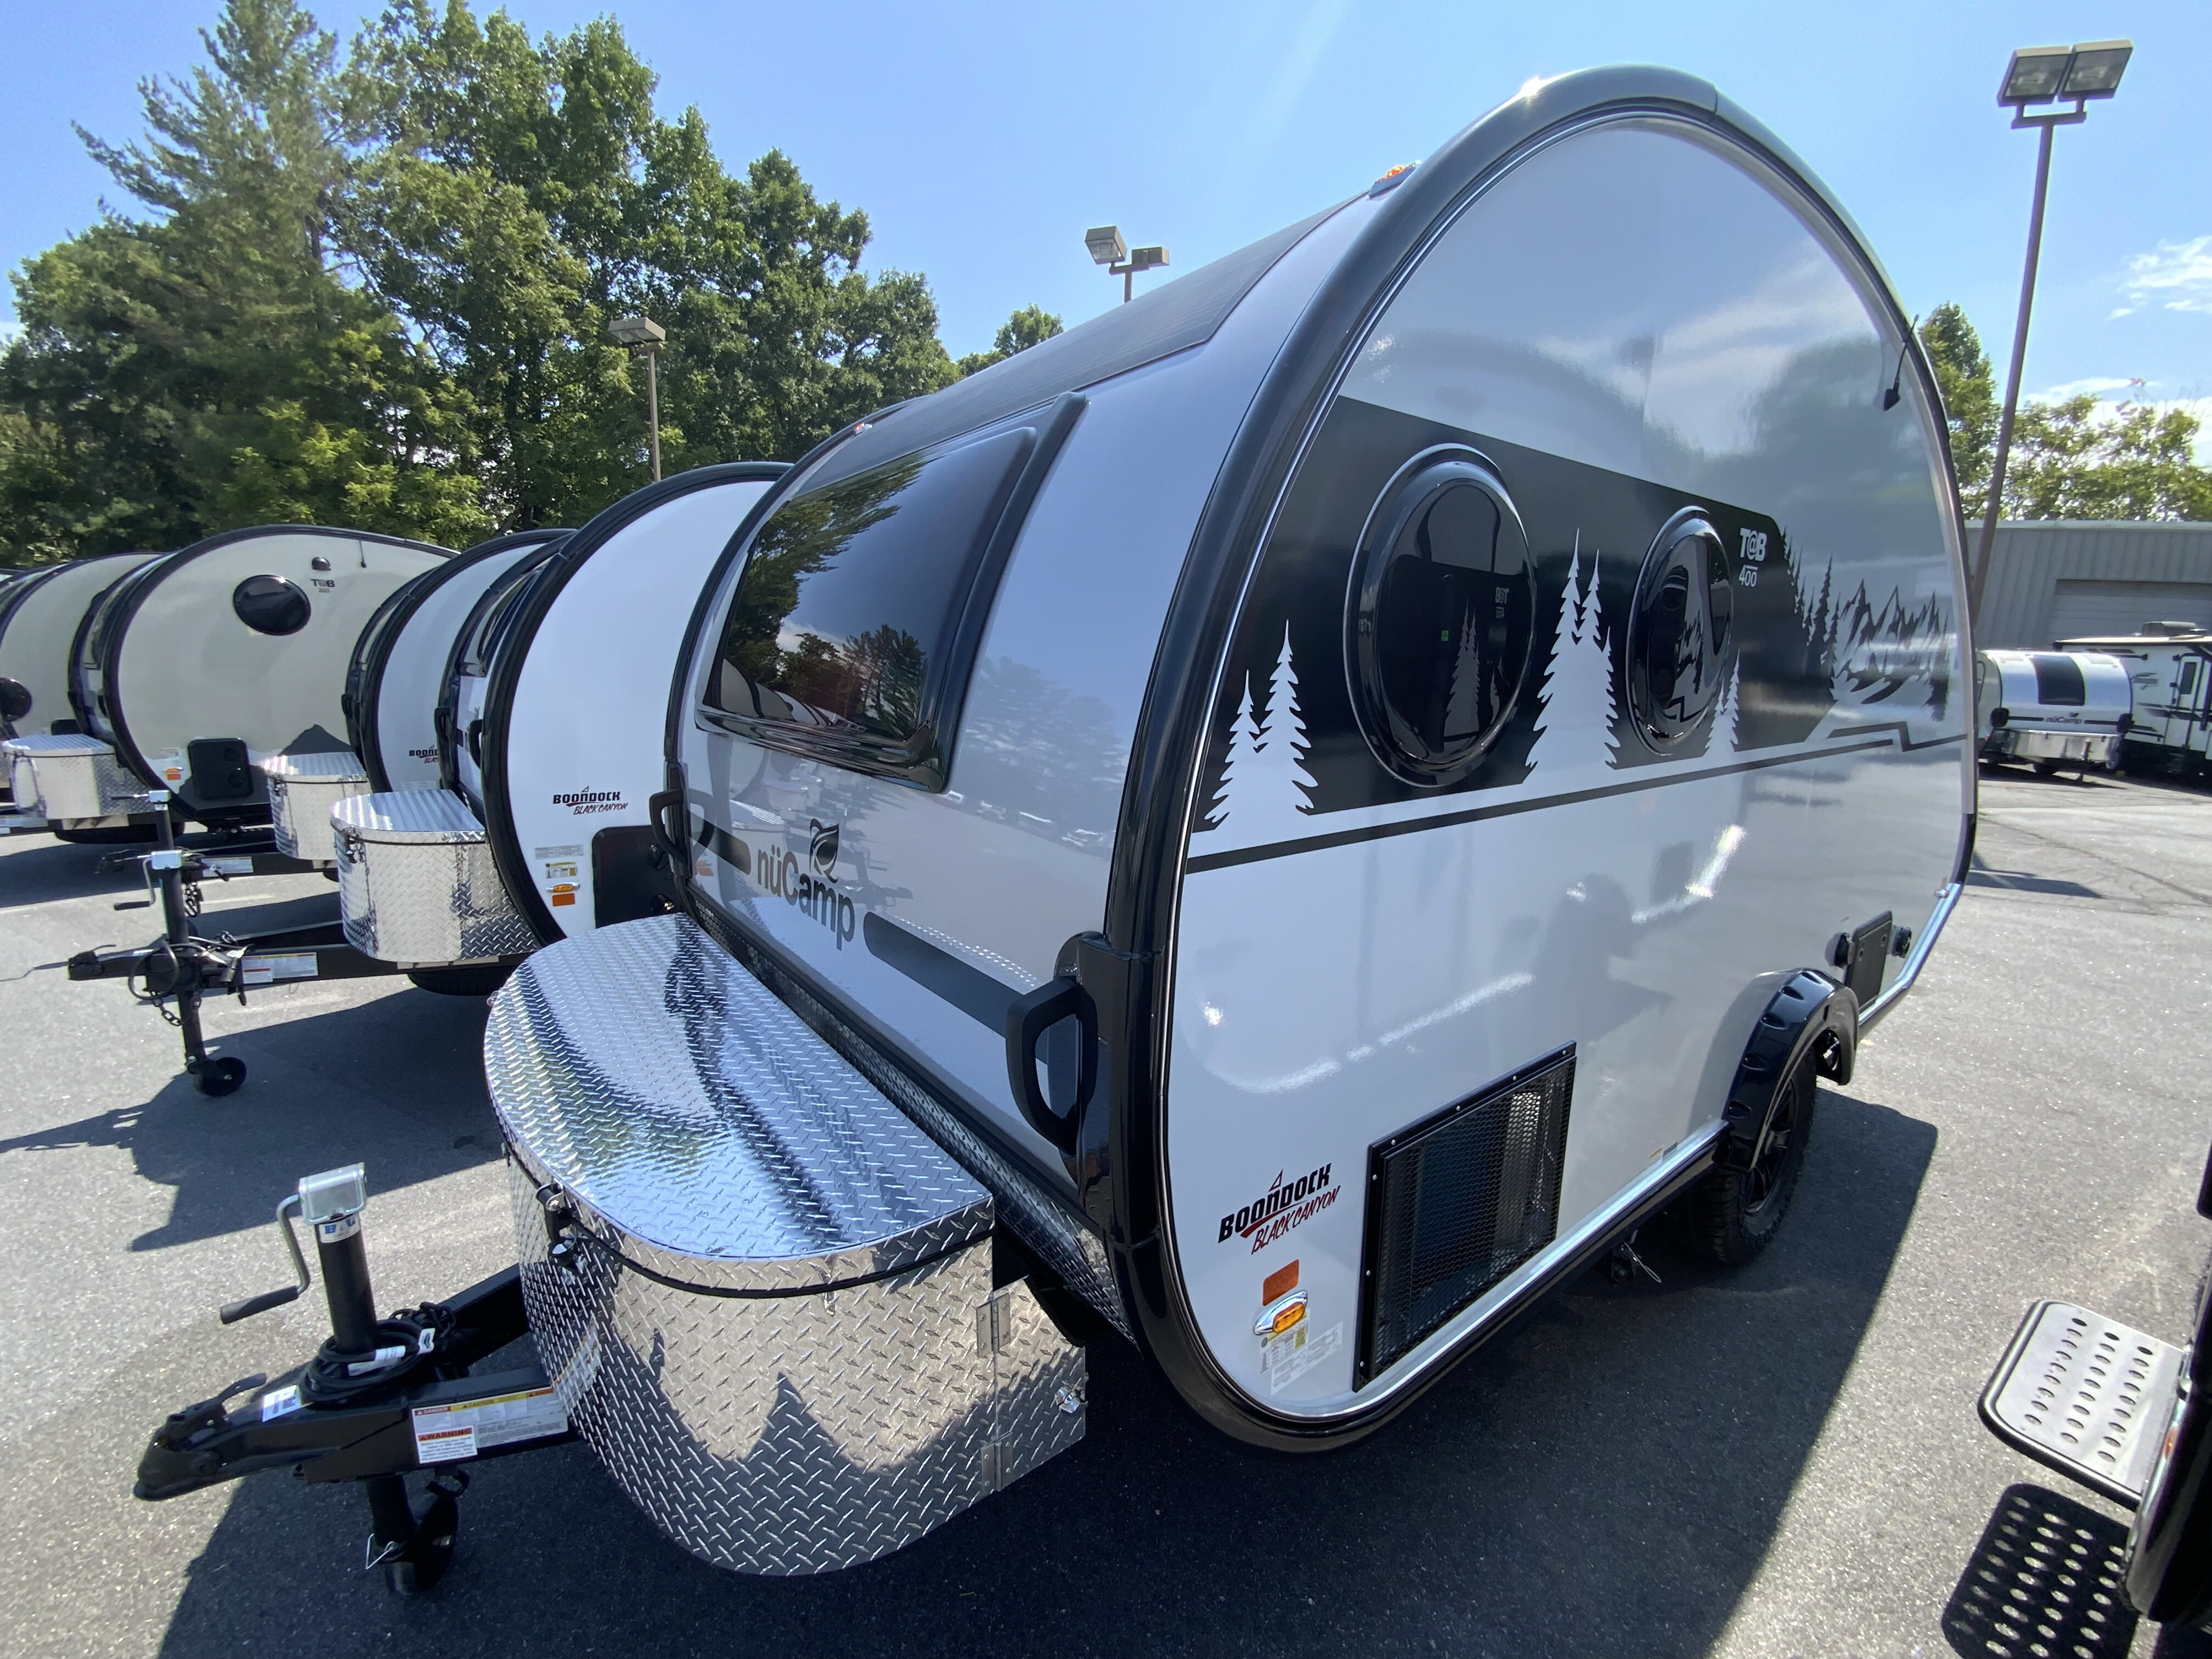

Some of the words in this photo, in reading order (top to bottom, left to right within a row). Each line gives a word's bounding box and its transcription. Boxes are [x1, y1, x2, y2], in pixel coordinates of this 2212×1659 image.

[1740, 527, 1767, 562] T@B
[310, 579, 335, 588] T@B
[1739, 565, 1758, 588] 400
[552, 791, 621, 804] BOONDOCK
[573, 804, 599, 815] BLACK
[598, 803, 628, 812] CANYON
[758, 844, 855, 952] nüCamp
[1218, 1163, 1332, 1244] BOONDOCK
[1251, 1212, 1293, 1255] BLACK
[1291, 1185, 1341, 1228] CANYON
[426, 1427, 472, 1440] WARNING
